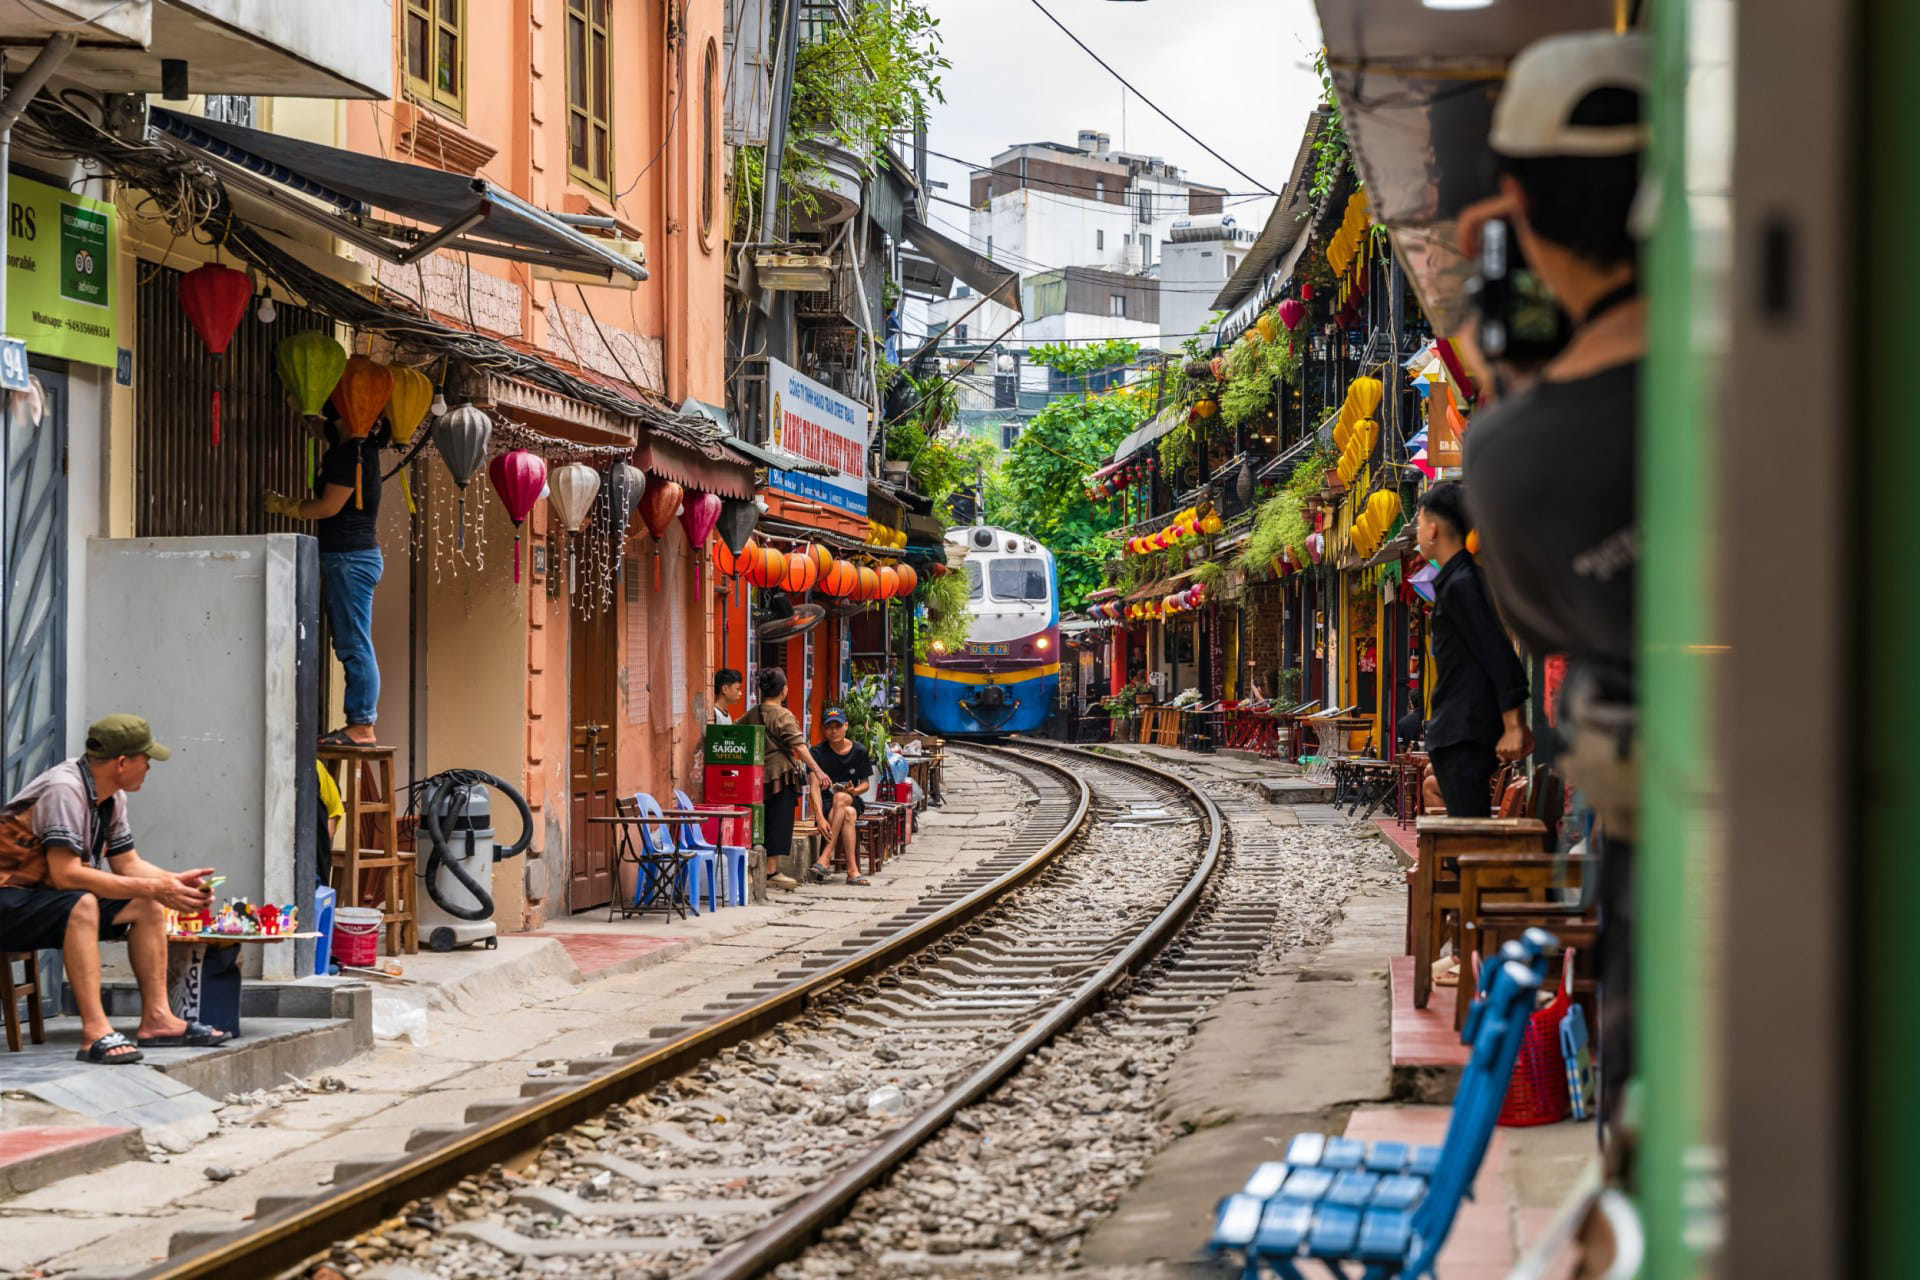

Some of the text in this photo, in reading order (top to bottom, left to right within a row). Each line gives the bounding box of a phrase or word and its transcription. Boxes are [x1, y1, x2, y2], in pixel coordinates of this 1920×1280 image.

[7, 201, 36, 241] RS
[63, 214, 105, 235] RECOMMENDED
[3, 347, 24, 382] 94
[118, 355, 130, 381] 90
[536, 550, 544, 569] 88
[712, 744, 747, 754] SAIGON
